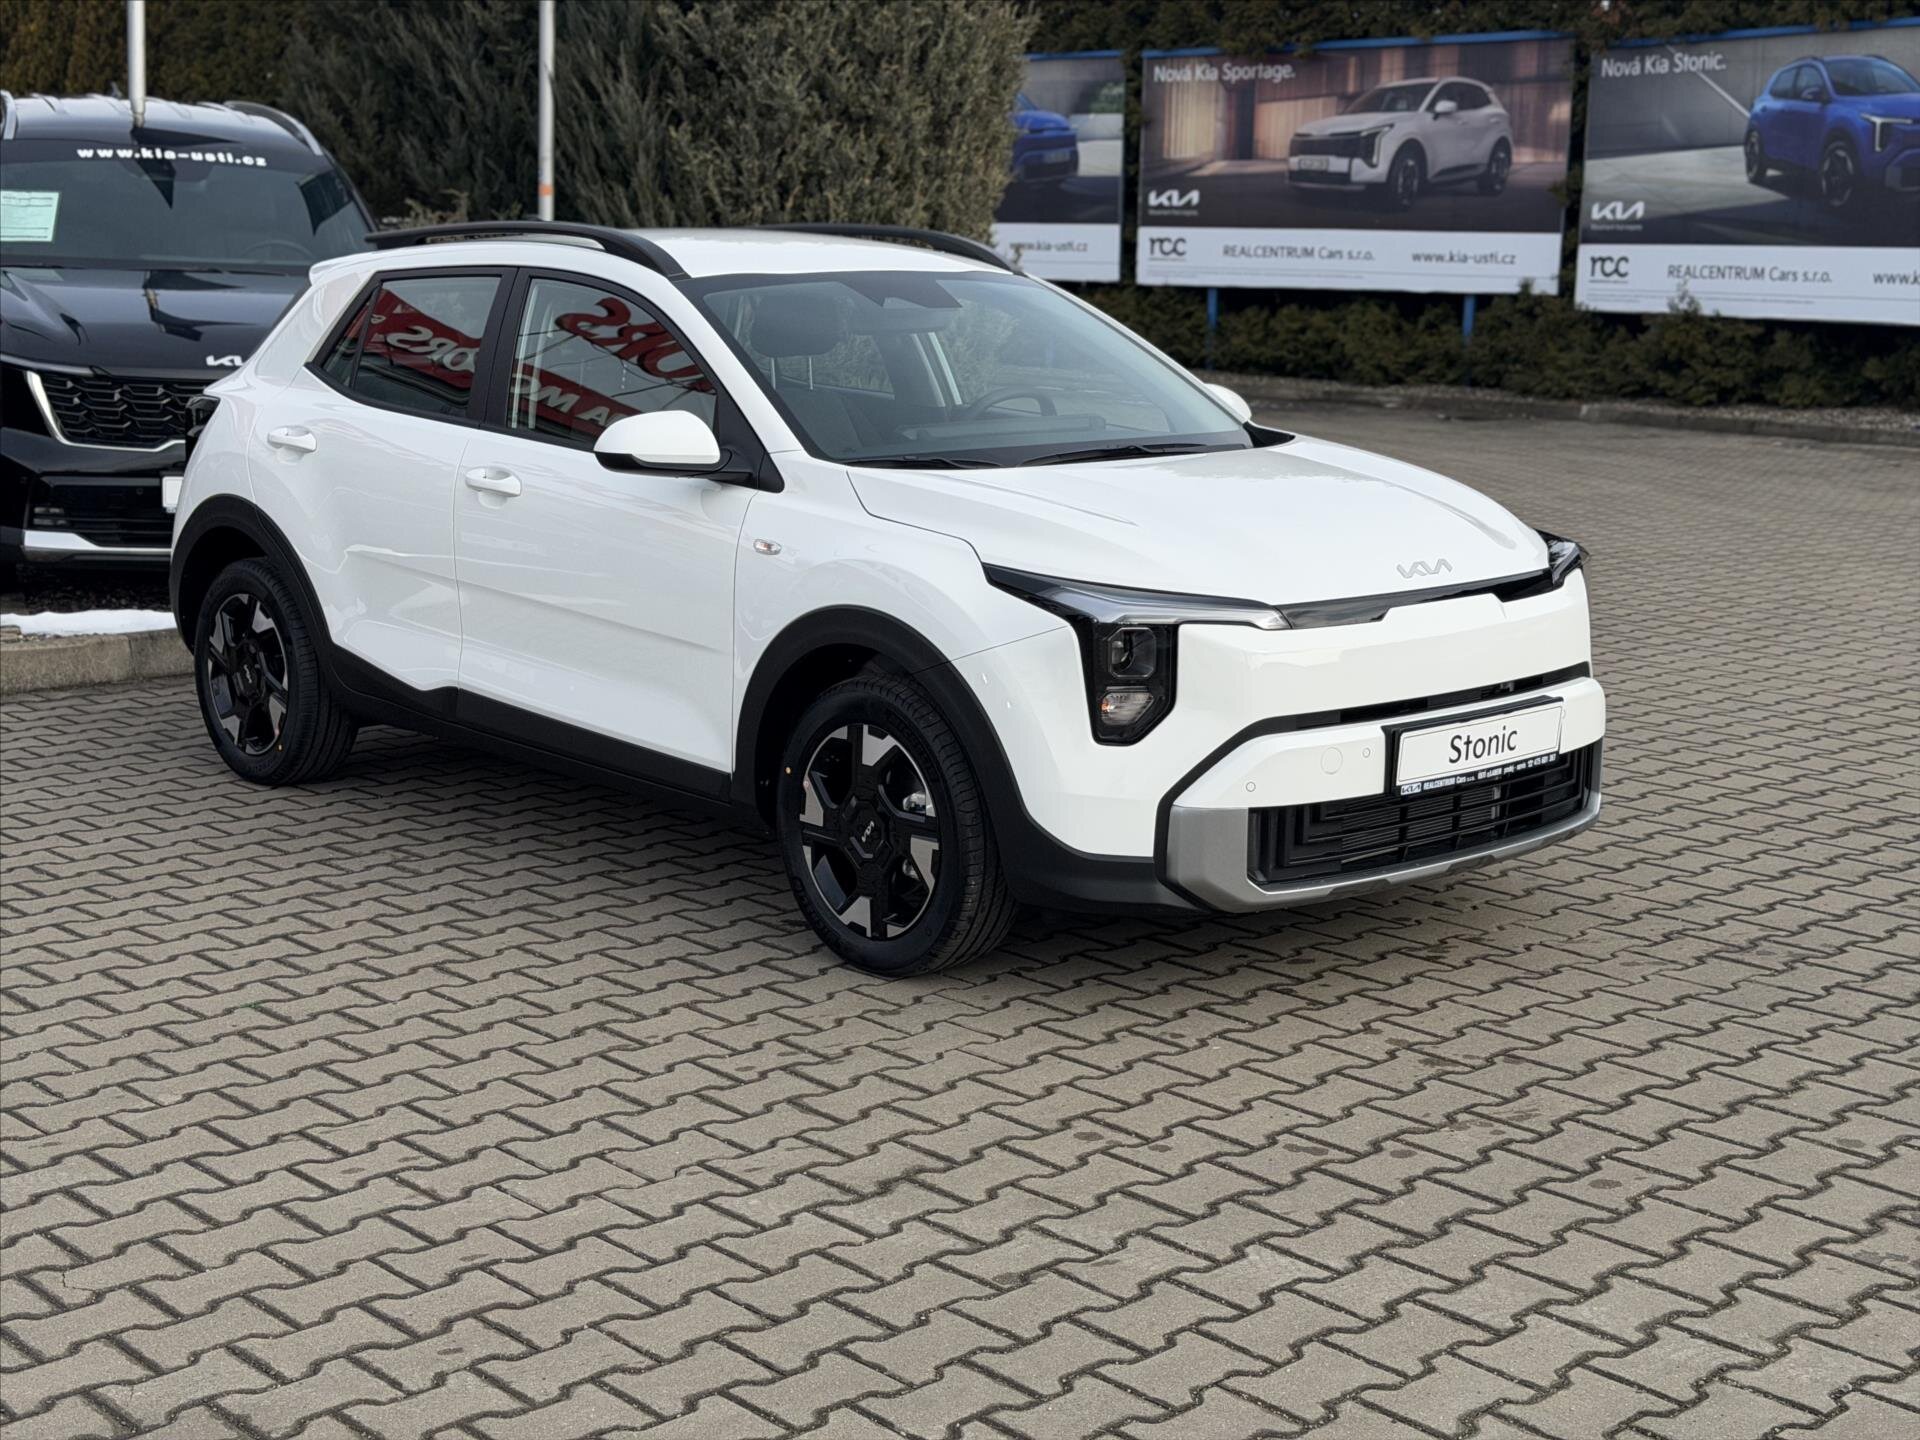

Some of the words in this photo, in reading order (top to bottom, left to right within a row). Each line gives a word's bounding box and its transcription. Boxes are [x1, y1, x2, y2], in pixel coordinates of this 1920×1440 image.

[1153, 64, 1192, 82] Nová
[1195, 63, 1219, 81] Kia
[1221, 61, 1296, 83] Sportage.
[1601, 56, 1641, 78] Nová
[1644, 54, 1670, 75] Kia
[1673, 51, 1727, 73] Stonic.
[77, 147, 267, 167] www.kia-usti.cz
[1148, 189, 1200, 207] KIA
[1591, 201, 1646, 220] KIA
[1222, 244, 1315, 259] REALCENTRUM
[1318, 246, 1344, 260] Cars
[1411, 250, 1517, 265] www.kia-usti.cz
[1667, 264, 1765, 281] REALCENTRUM
[1768, 266, 1799, 282] Cars
[1448, 724, 1518, 764] Stonic
